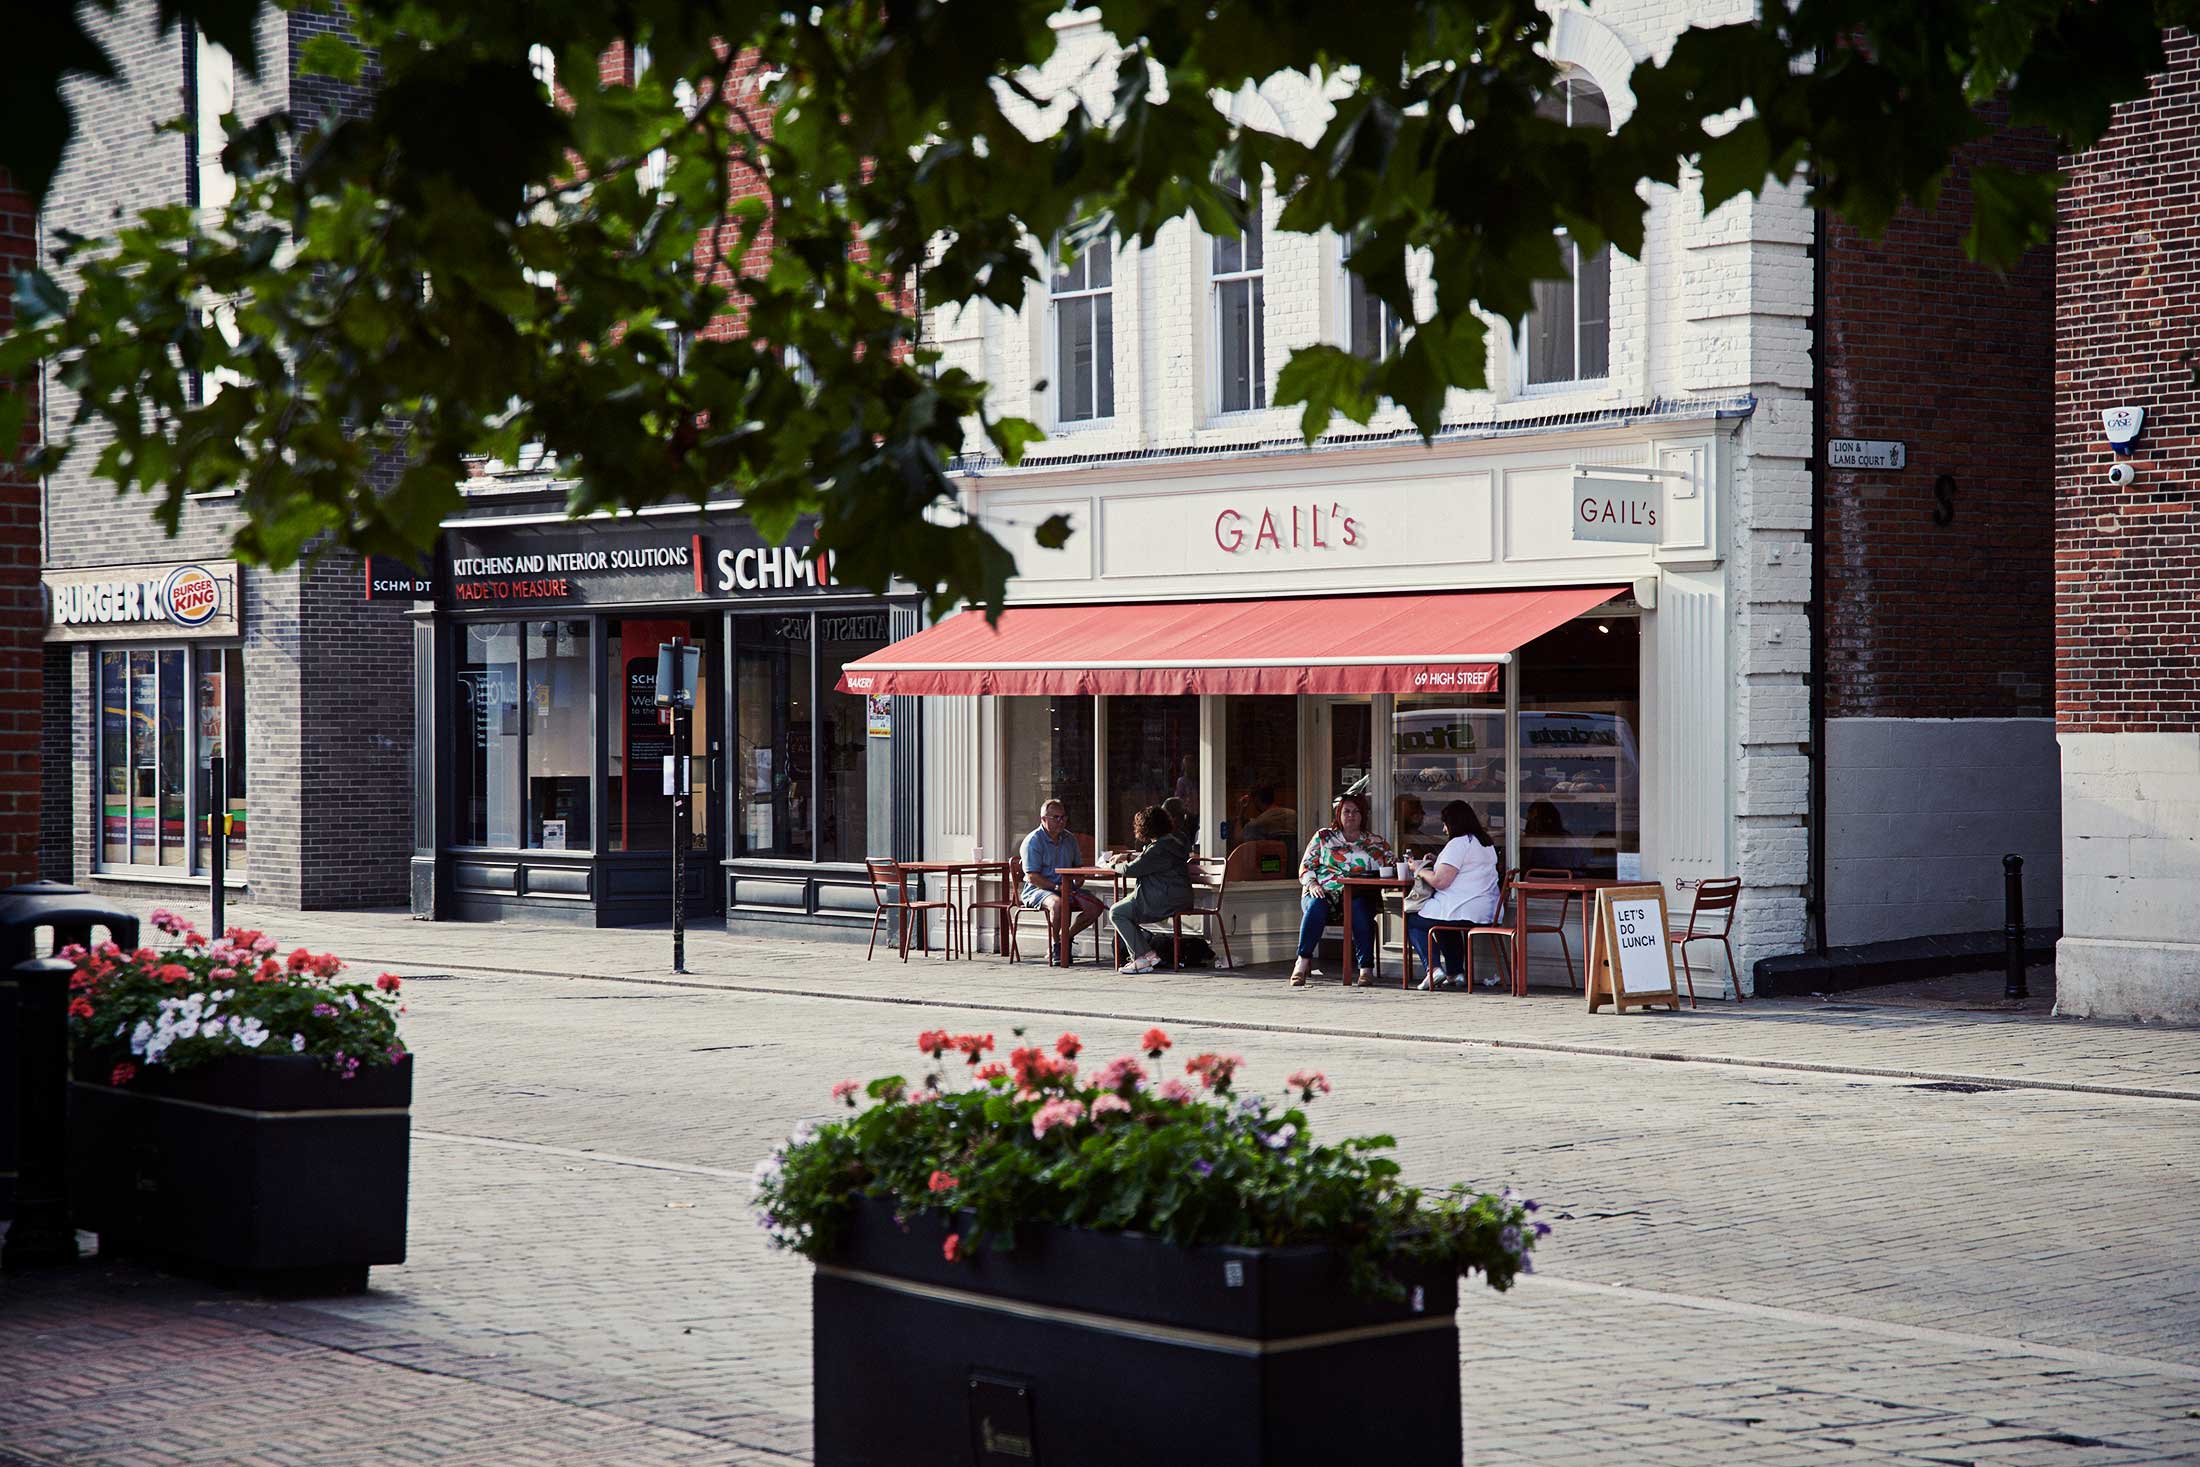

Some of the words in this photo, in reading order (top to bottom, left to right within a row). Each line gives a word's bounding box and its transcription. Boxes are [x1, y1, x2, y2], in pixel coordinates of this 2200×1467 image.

[1834, 442, 1854, 452] LION
[1855, 443, 1862, 452] &
[1834, 455, 1856, 465] LAMB
[1858, 456, 1885, 466] COURT
[1580, 498, 1657, 526] GAIL's
[1215, 502, 1357, 552] GAIL's
[453, 555, 514, 577] KITCHENS
[515, 554, 545, 574] AND
[547, 551, 609, 573] INTERIOR
[610, 546, 689, 569] SOLUTIONS
[173, 579, 213, 599] BURGER
[455, 581, 490, 600] MADE
[490, 580, 509, 599] TO
[512, 578, 569, 599] MEASURE
[53, 582, 141, 624] BURGER
[174, 589, 214, 613] KING
[631, 674, 658, 684] SCH
[847, 677, 875, 689] BAKERY
[1414, 672, 1428, 686] 69
[1429, 672, 1455, 686] HIGH
[1456, 671, 1489, 685] STREET
[642, 706, 656, 715] the
[1618, 909, 1645, 922] LET'S
[1620, 923, 1636, 935] DO
[1622, 935, 1656, 949] LUNCH
